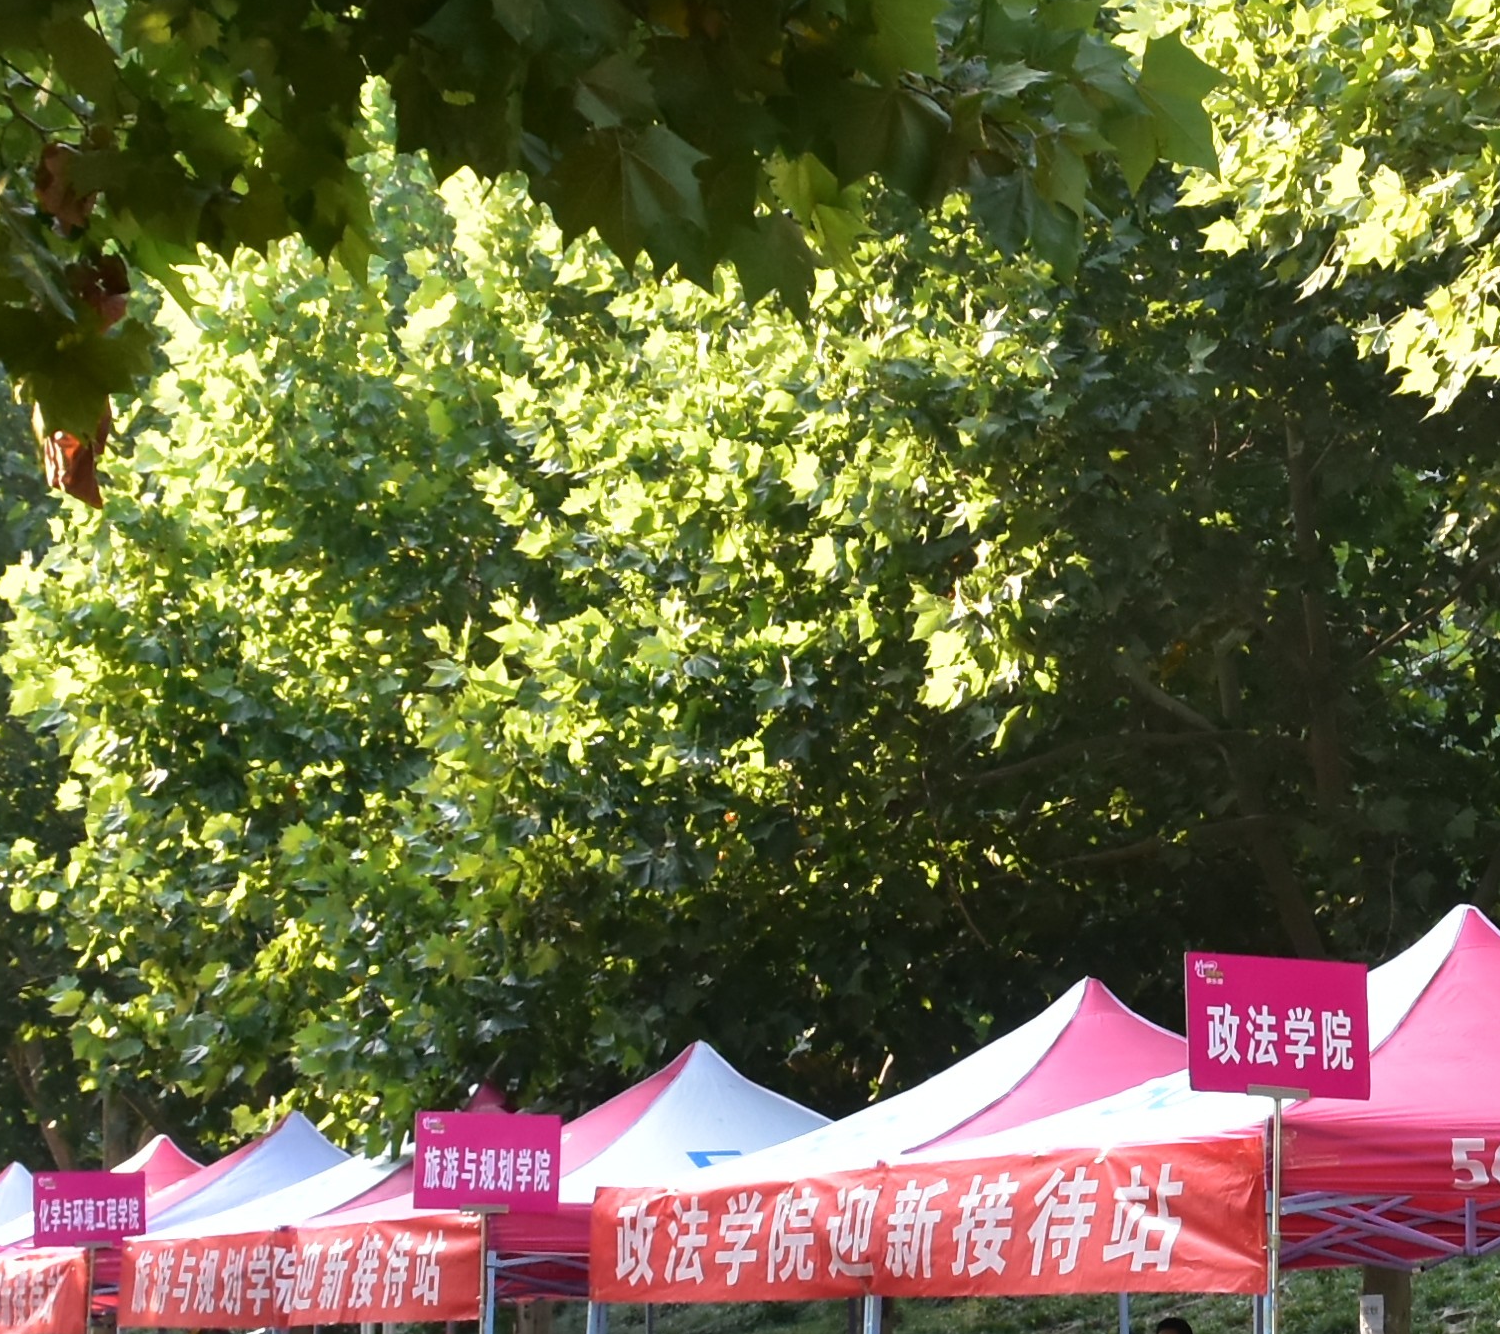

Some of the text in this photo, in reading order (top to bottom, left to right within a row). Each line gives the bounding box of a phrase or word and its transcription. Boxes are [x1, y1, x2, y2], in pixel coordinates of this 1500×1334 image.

[1206, 1002, 1354, 1071] 政法学院
[422, 1145, 551, 1193] 旅游与规划学院
[39, 1198, 140, 1233] 化学与环境工程学院
[613, 1161, 1185, 1288] 政法学院迎新接待站
[130, 1229, 447, 1316] 旅游与规划学院迎新接待站
